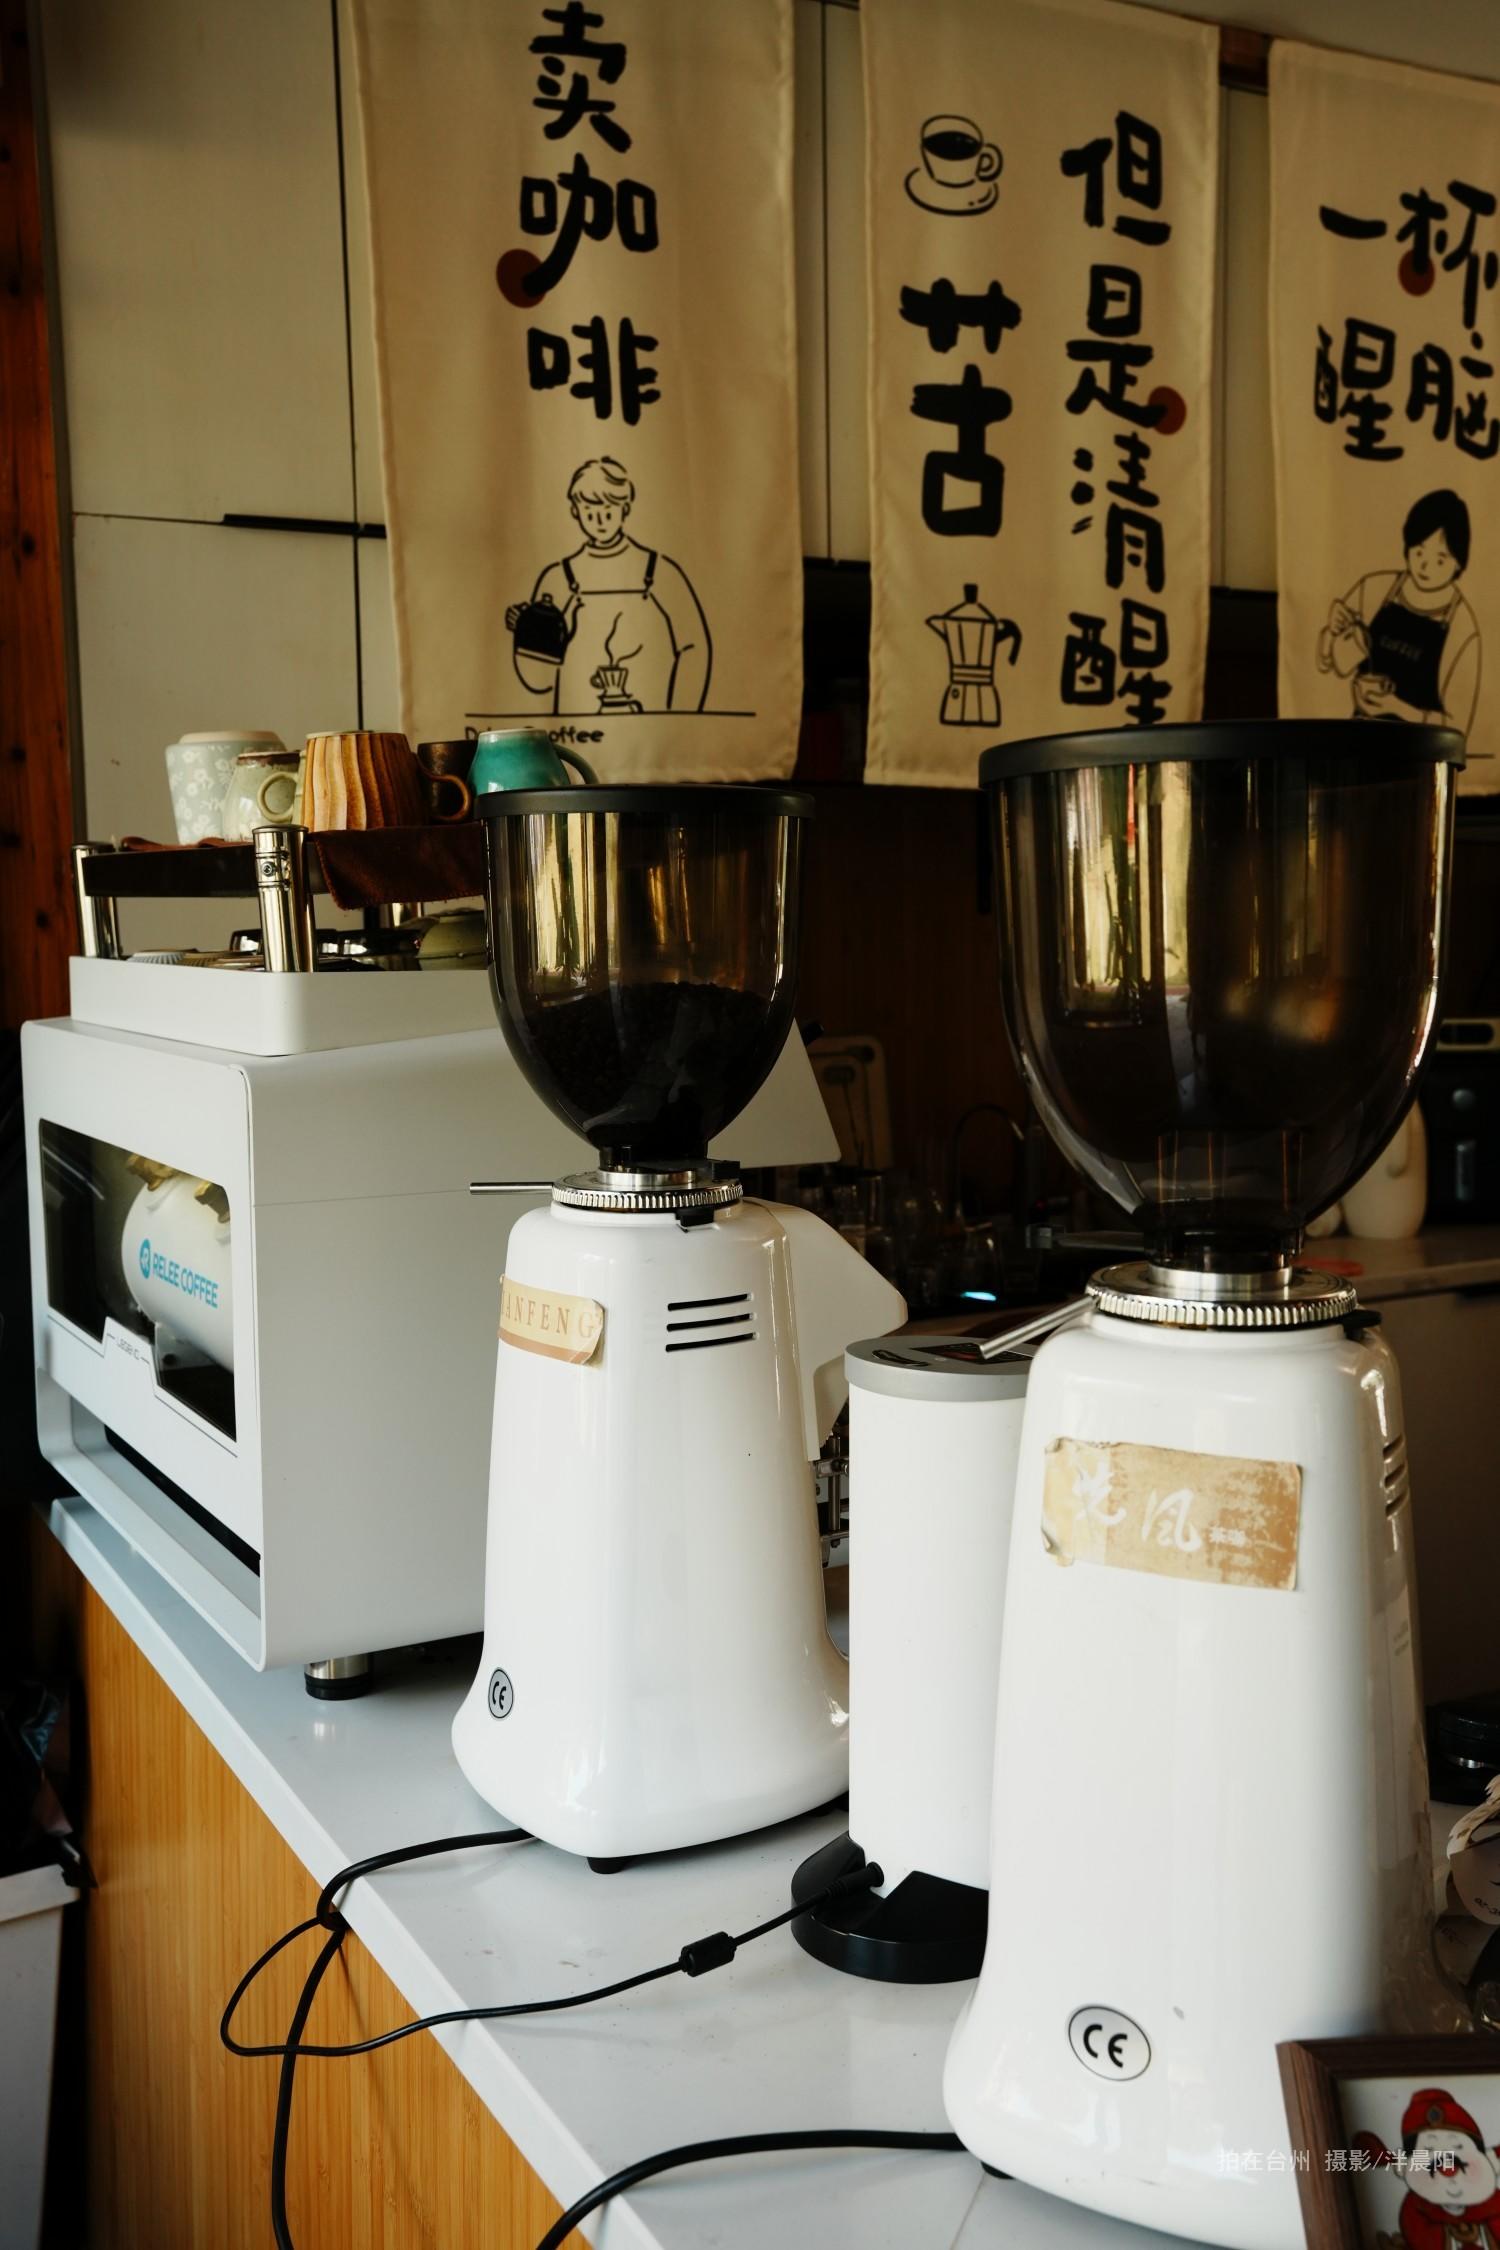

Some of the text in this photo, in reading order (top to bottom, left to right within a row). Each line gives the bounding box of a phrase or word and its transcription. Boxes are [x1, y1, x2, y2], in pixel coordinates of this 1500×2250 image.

[519, 1, 662, 427] 卖咖啡
[1319, 180, 1499, 329] 一杯
[899, 278, 1022, 537] 苦
[1061, 110, 1173, 727] 但是清醒
[1314, 318, 1500, 461] 醒脑
[523, 726, 604, 743] offee
[153, 1252, 219, 1310] RELEE COFFEE
[491, 1680, 507, 1710] CE
[1083, 2023, 1128, 2068] CE
